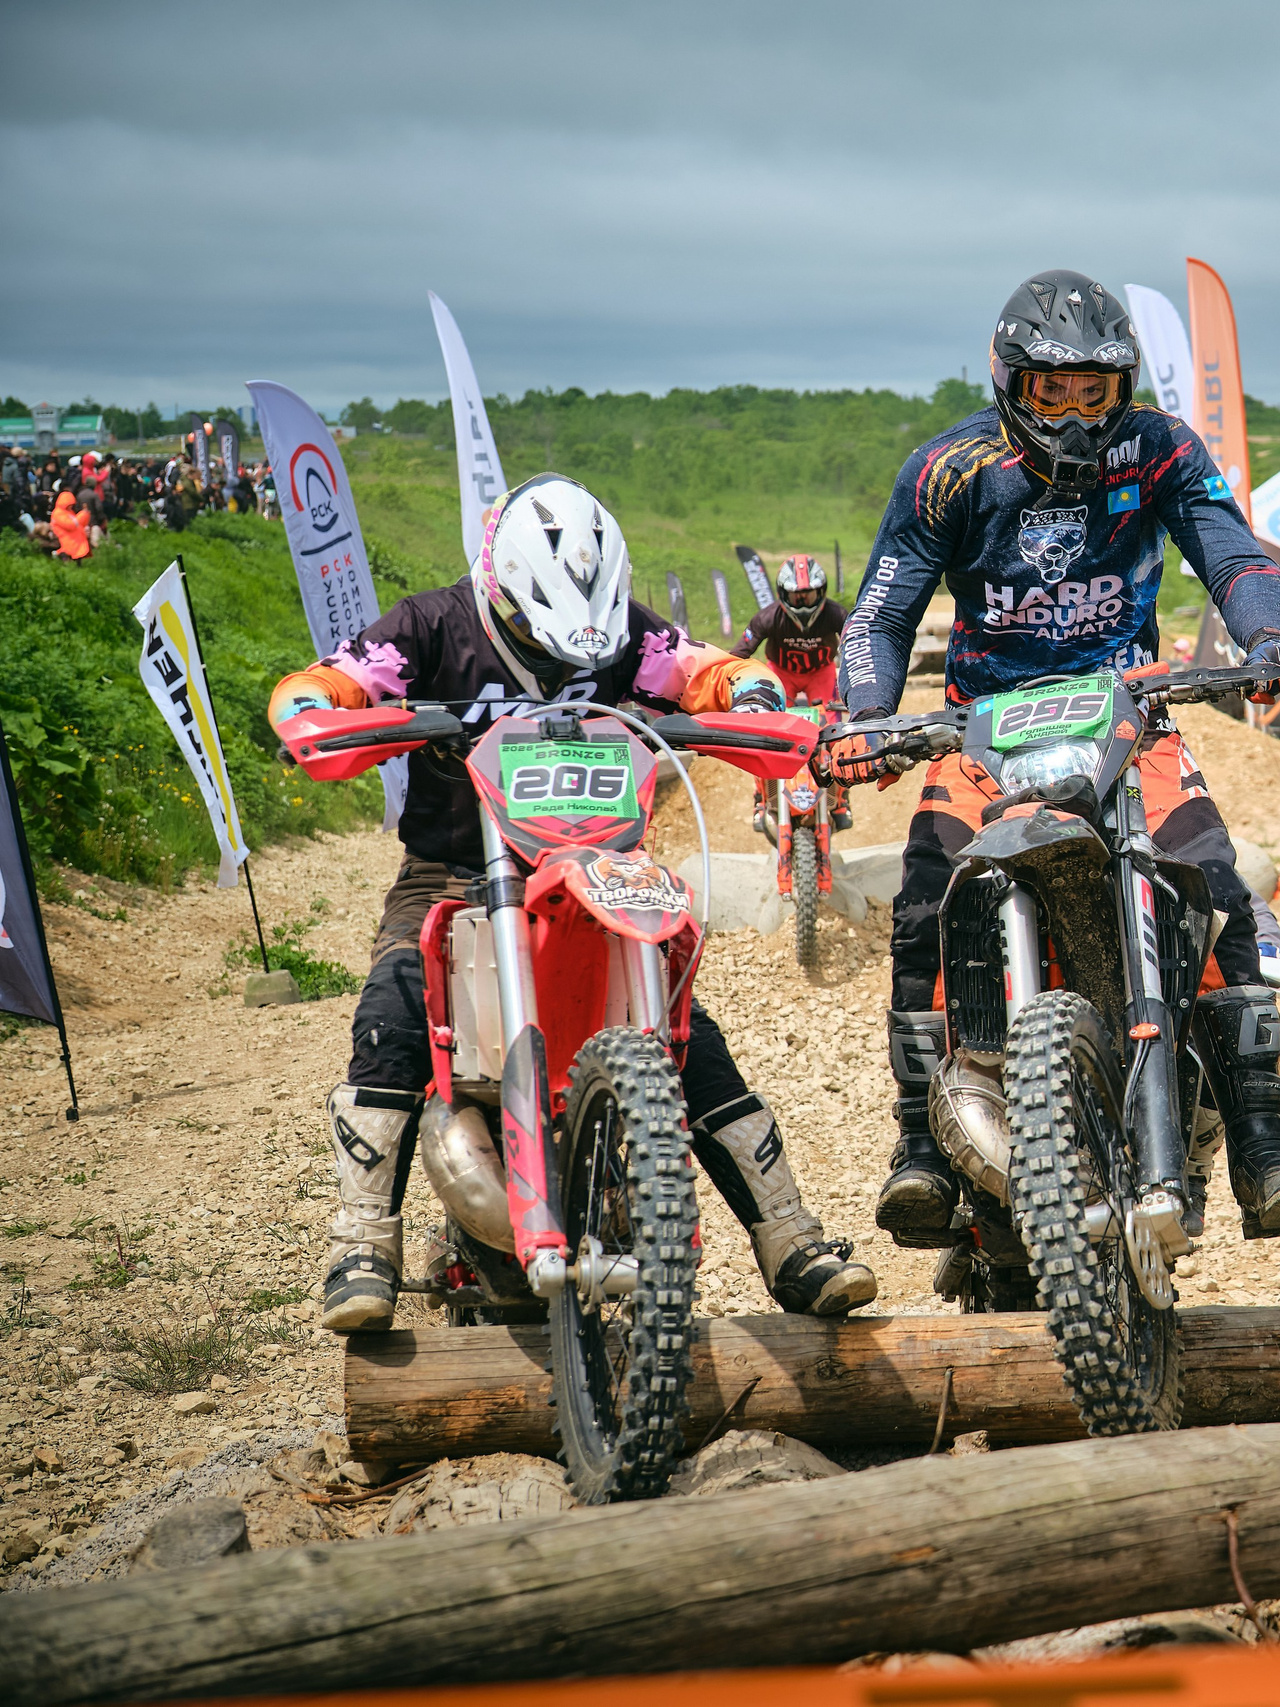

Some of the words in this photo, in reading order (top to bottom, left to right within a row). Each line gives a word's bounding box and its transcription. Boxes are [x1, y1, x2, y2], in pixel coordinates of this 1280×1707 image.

[1033, 341, 1076, 361] Airoh
[311, 500, 334, 522] РСК
[876, 555, 899, 581] GO
[984, 574, 1123, 611] HARD
[983, 598, 1123, 627] ENDURO
[1034, 615, 1122, 640] ALMATY
[1022, 682, 1090, 698] BRONZE
[995, 692, 1110, 738] 295
[1019, 723, 1072, 737] Голышев
[1025, 729, 1068, 740] Андрей
[535, 749, 606, 760] BRONZE
[510, 762, 629, 802] 206
[533, 804, 564, 813] Рада
[567, 802, 617, 812] Николай
[589, 886, 689, 909] ТВОРОЖКИ
